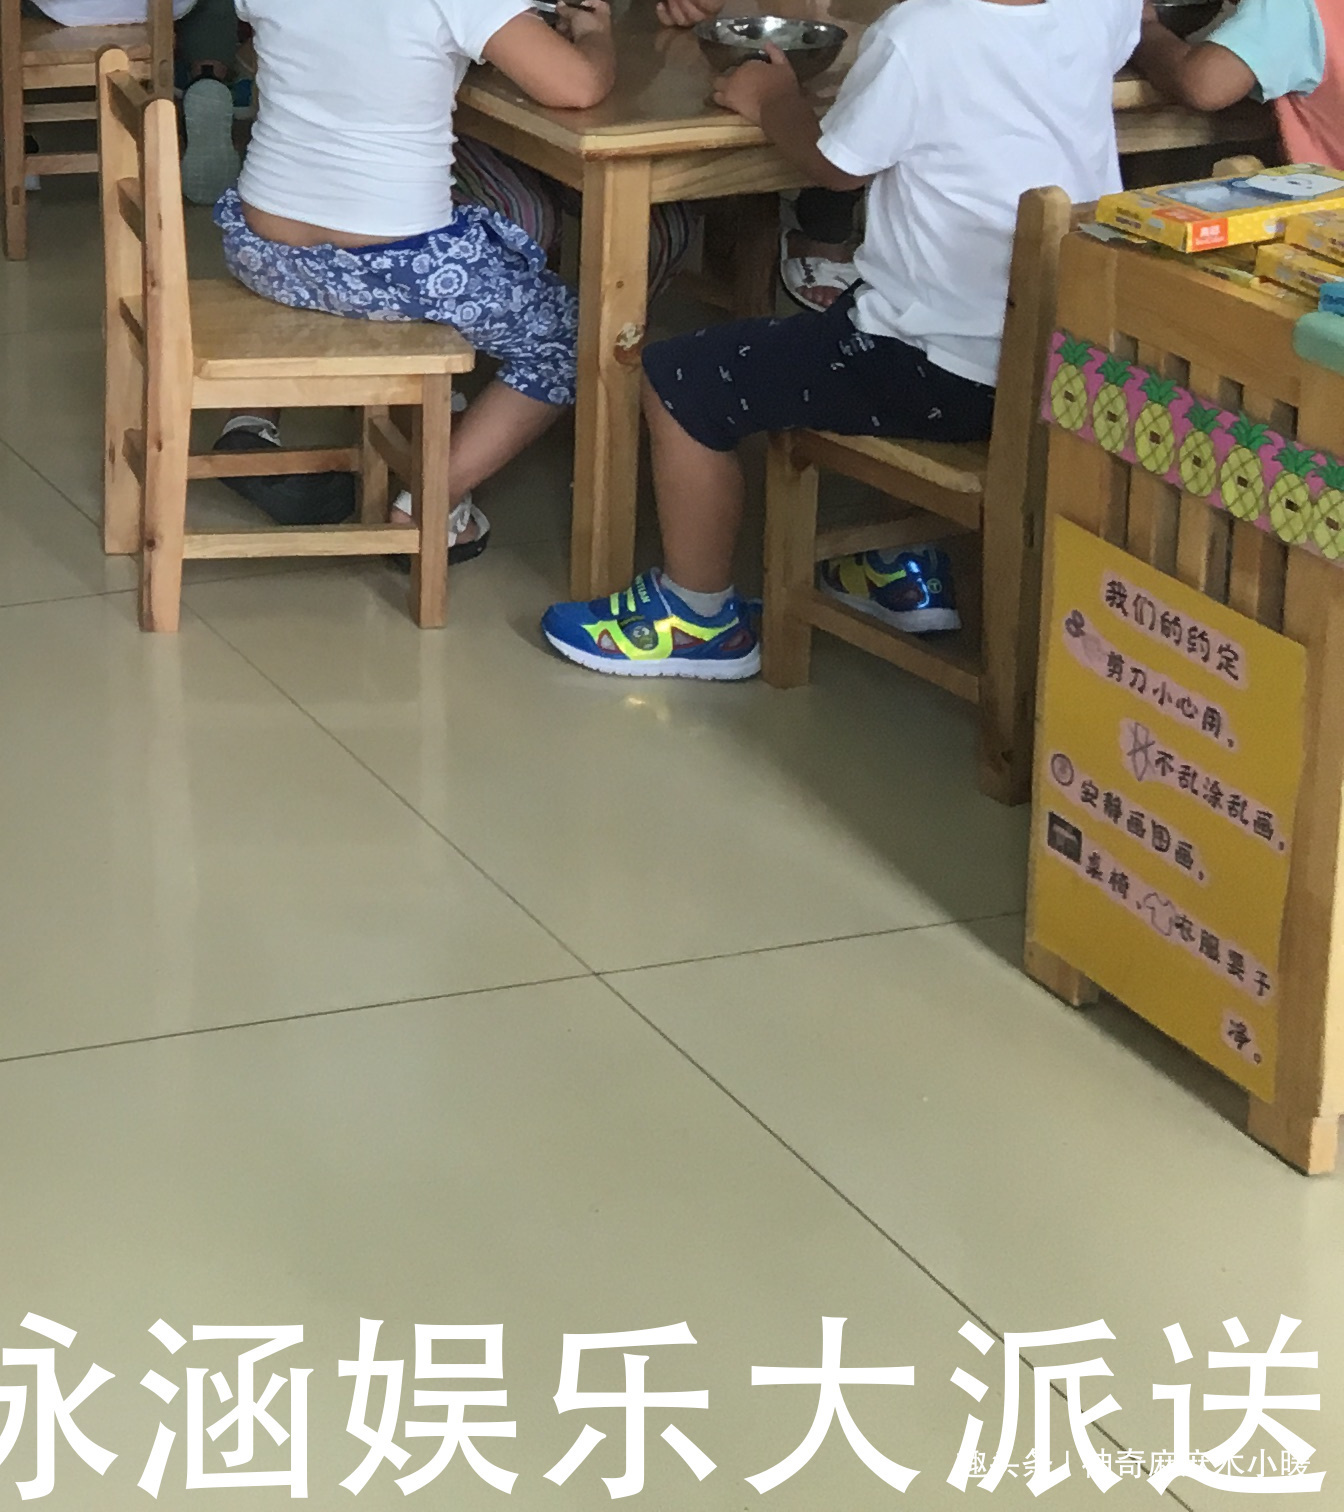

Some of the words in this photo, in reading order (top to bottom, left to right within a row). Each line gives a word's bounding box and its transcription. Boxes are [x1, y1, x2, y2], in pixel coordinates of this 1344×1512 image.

[1105, 579, 1239, 681] 我们的约定
